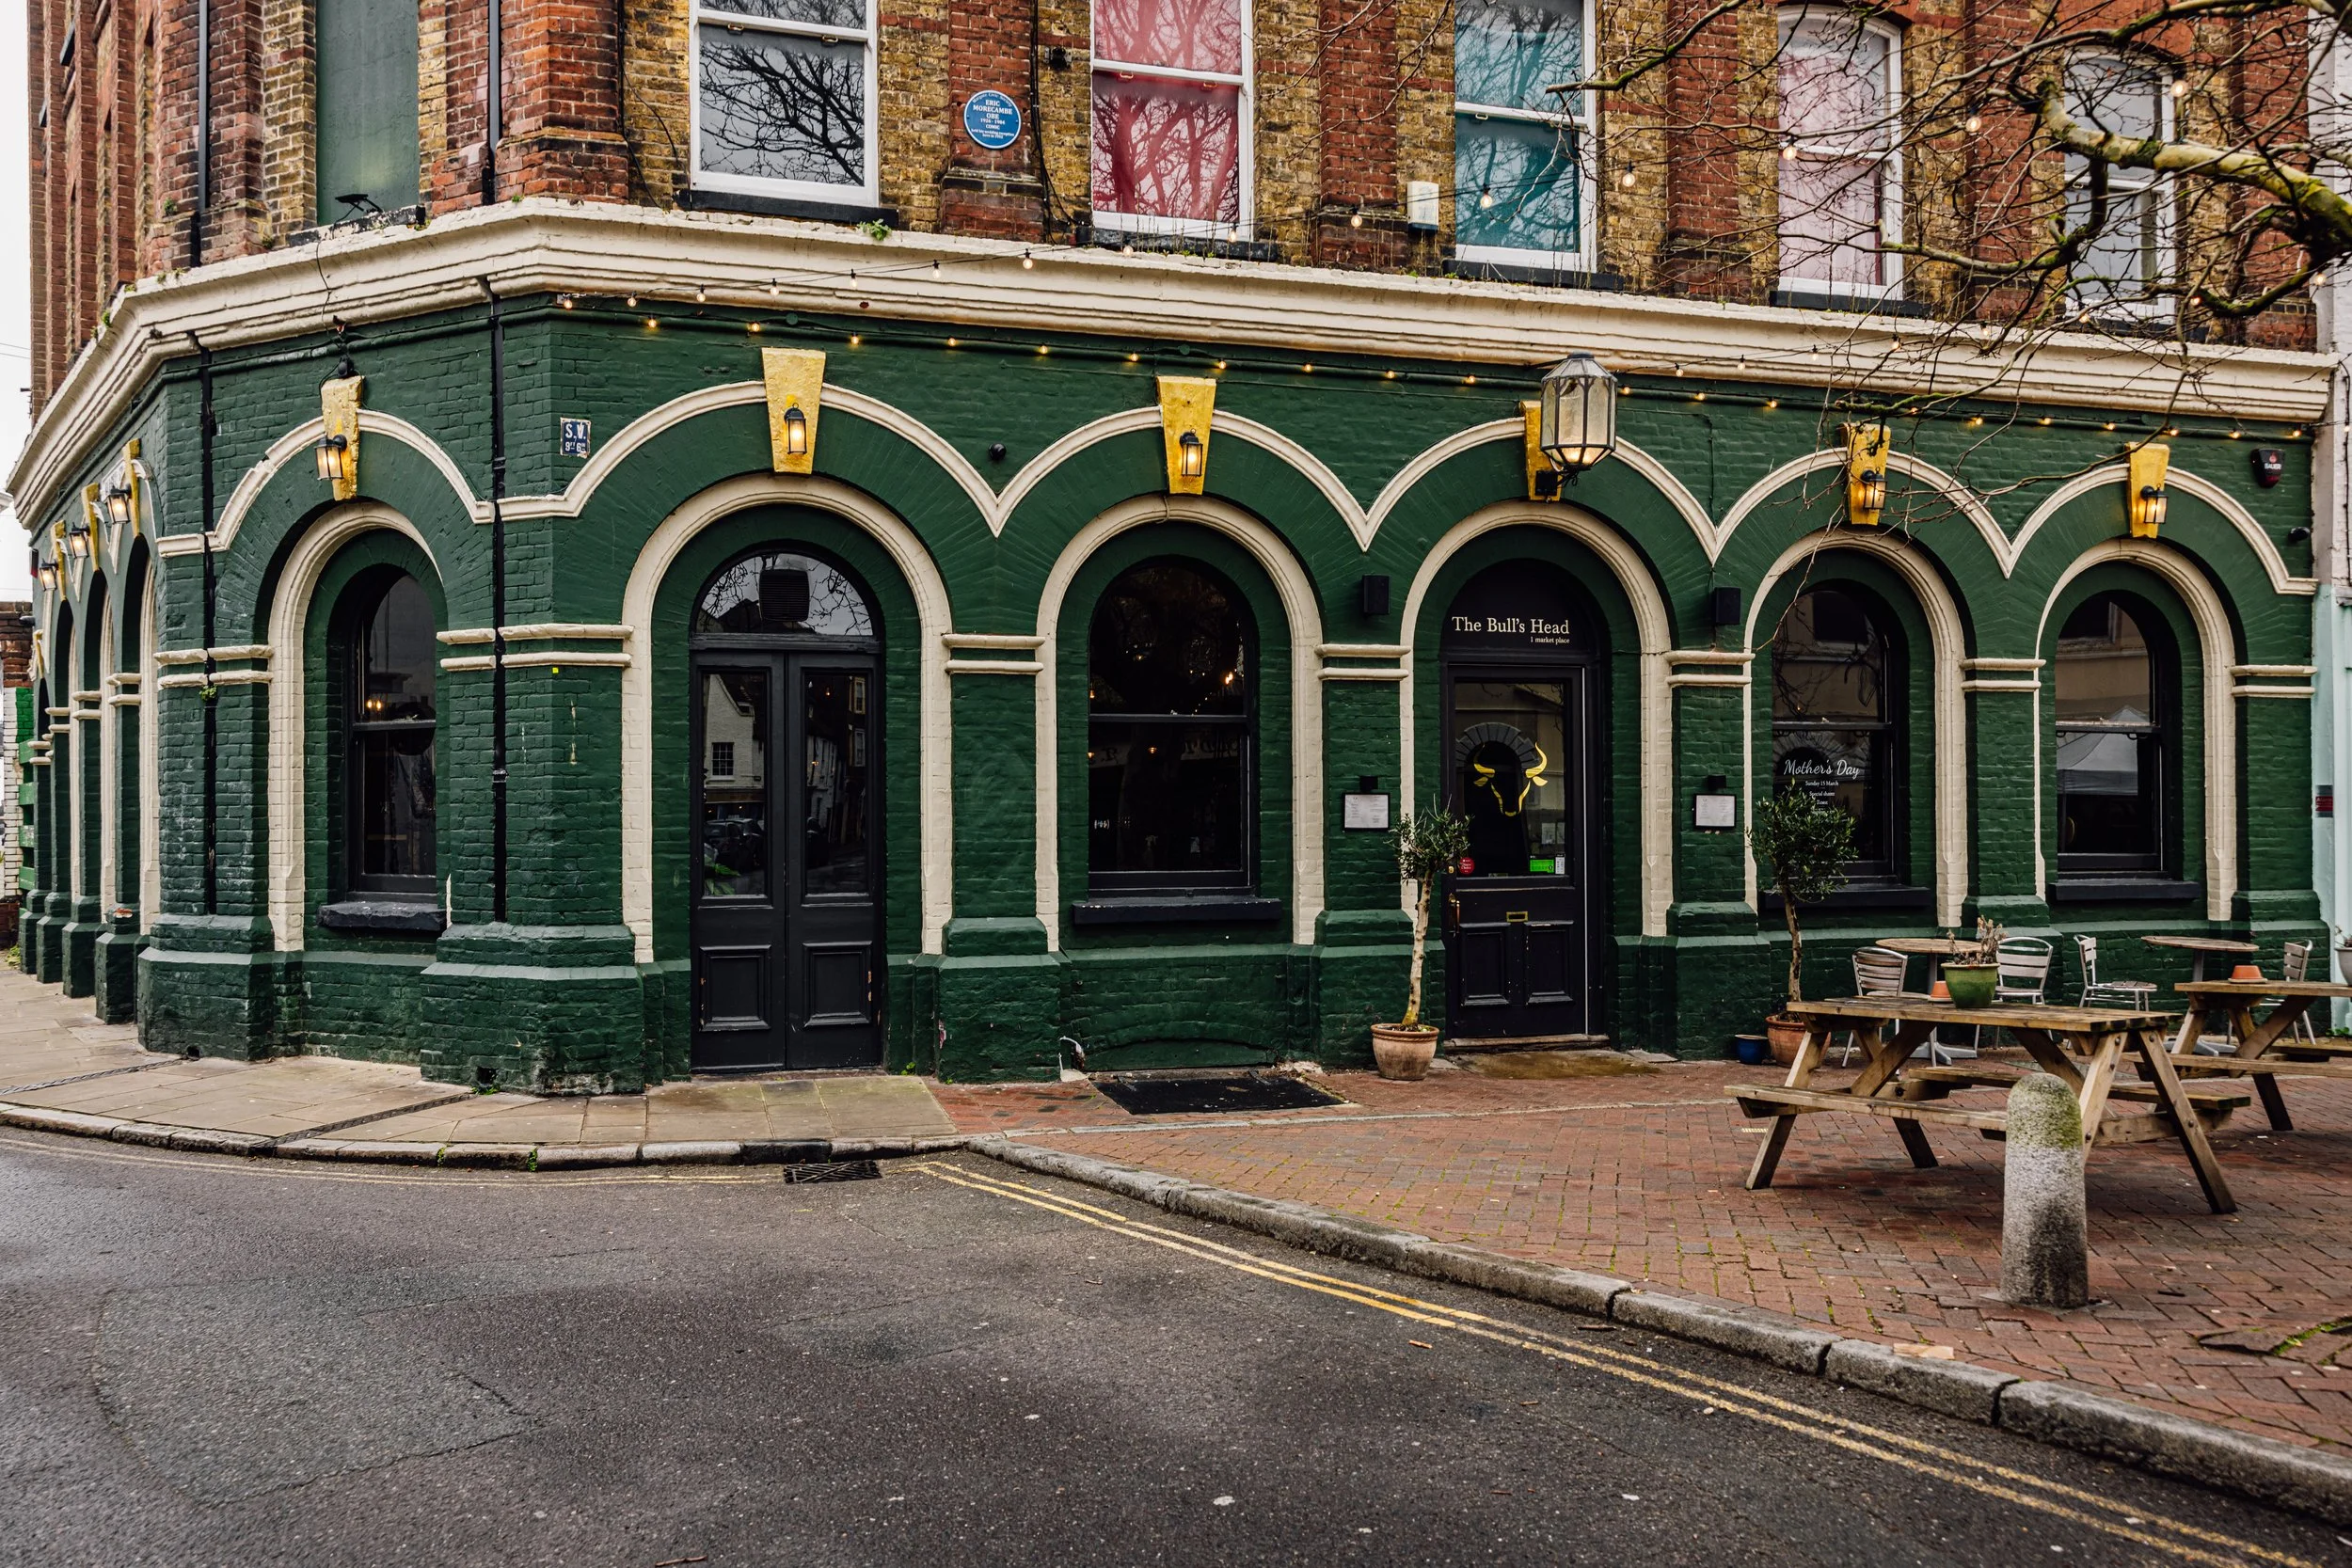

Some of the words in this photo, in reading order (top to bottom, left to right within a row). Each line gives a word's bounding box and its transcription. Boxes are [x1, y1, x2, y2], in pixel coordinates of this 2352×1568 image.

[973, 104, 1012, 115] MORECAMBE
[1452, 616, 1482, 631] The
[1486, 617, 1525, 633] Bull's
[1530, 618, 1570, 634] Head
[1555, 637, 1570, 645] place
[1783, 759, 1834, 776] Mother's
[1836, 759, 1861, 780] Day
